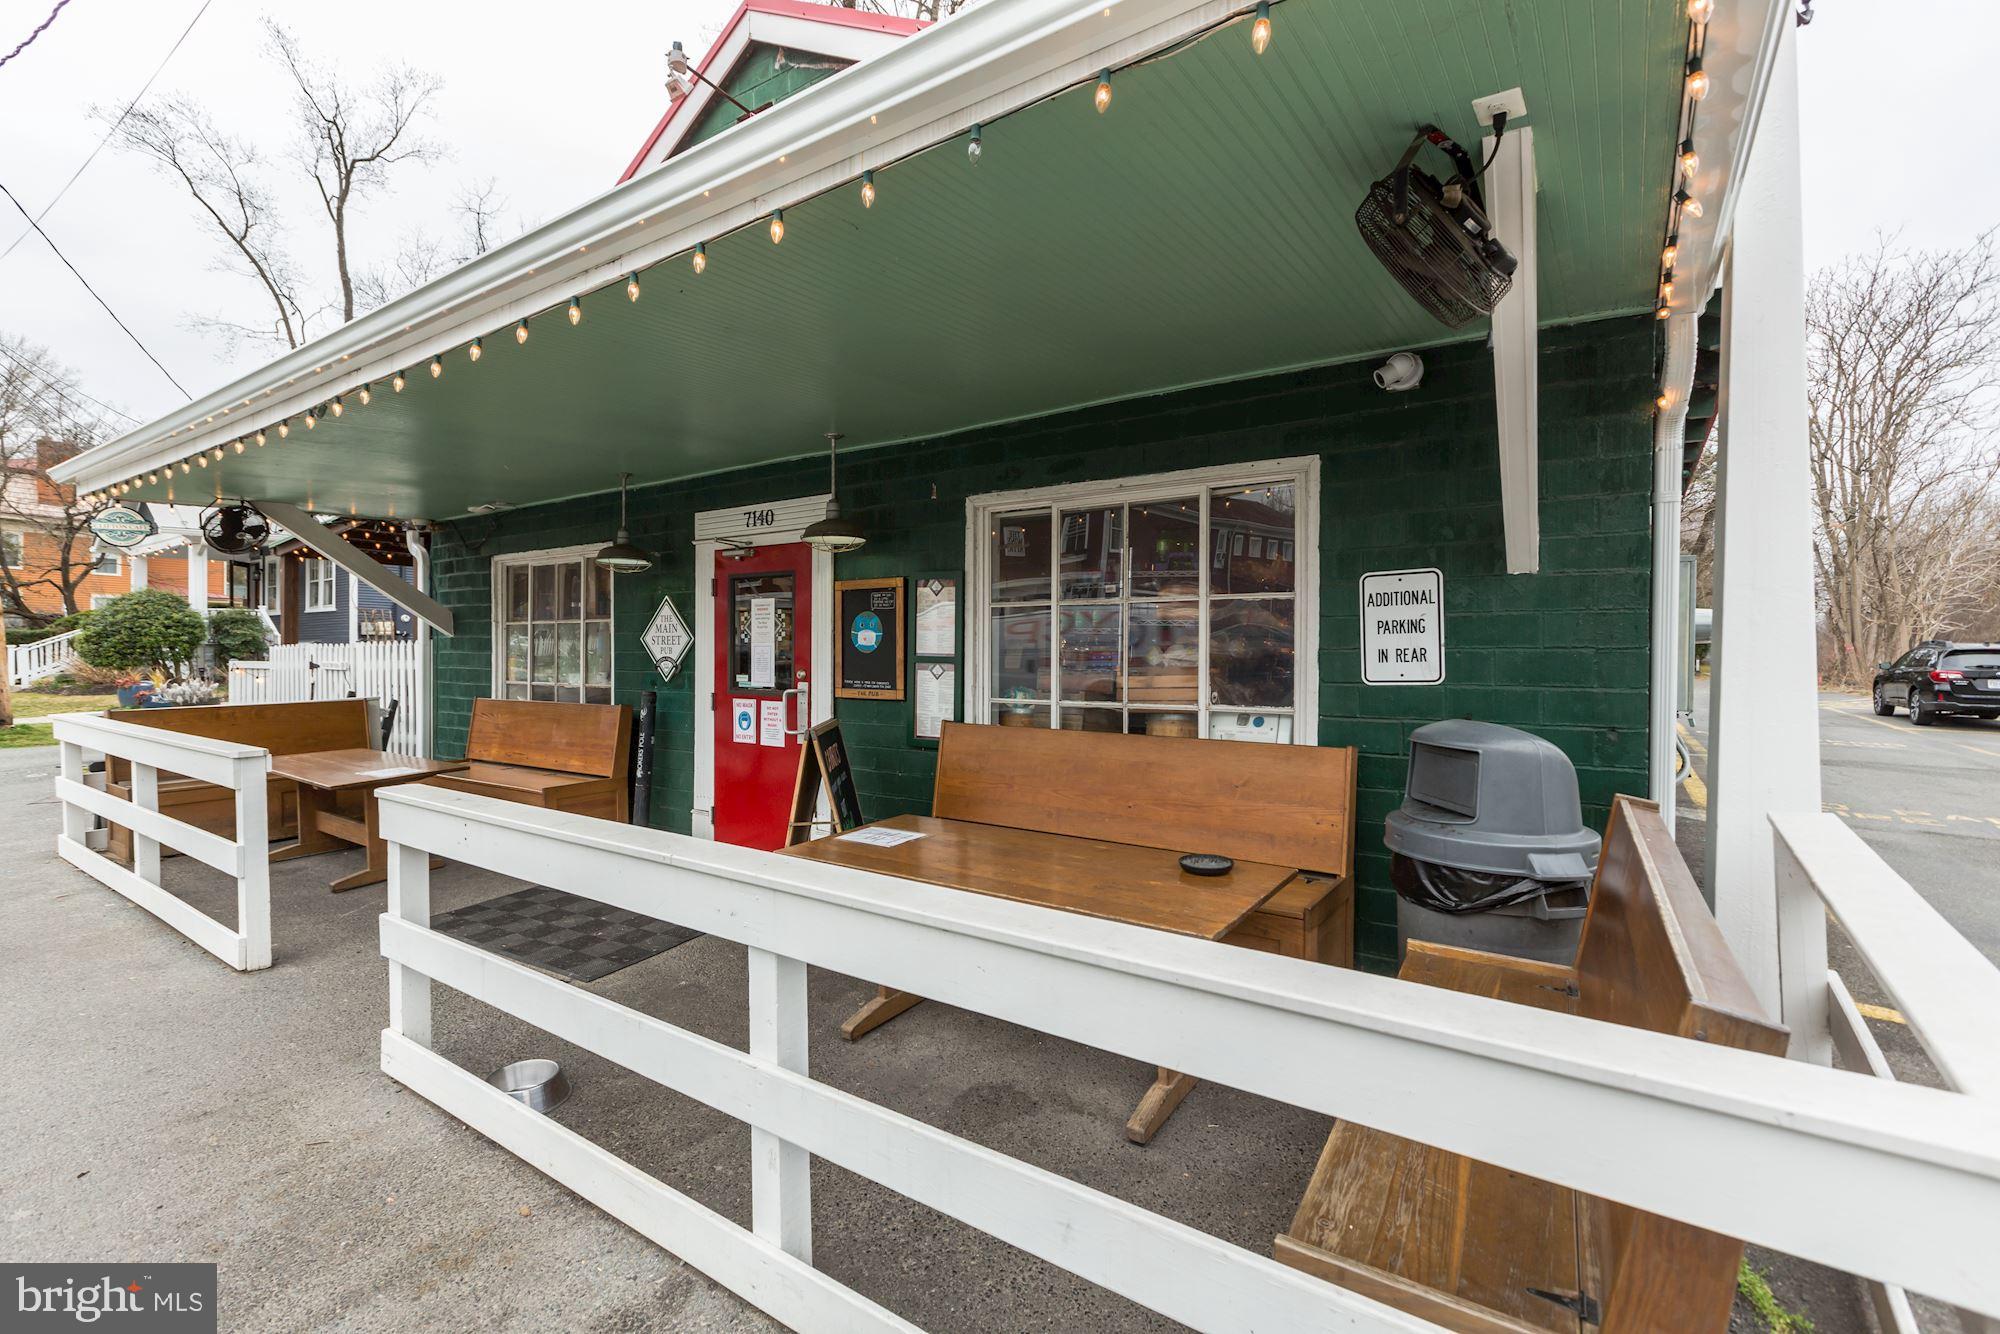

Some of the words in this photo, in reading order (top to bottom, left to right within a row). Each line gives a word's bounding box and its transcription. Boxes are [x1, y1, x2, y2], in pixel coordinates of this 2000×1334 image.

[743, 509, 774, 528] 7140
[1366, 589, 1436, 608] ADDITIONAL
[660, 614, 673, 623] THE
[655, 623, 678, 634] MAIN
[1377, 618, 1426, 635] PARKING
[651, 635, 682, 646] STREET
[660, 646, 673, 655] PUB
[1378, 648, 1389, 664] IN
[1395, 647, 1428, 664] REAR
